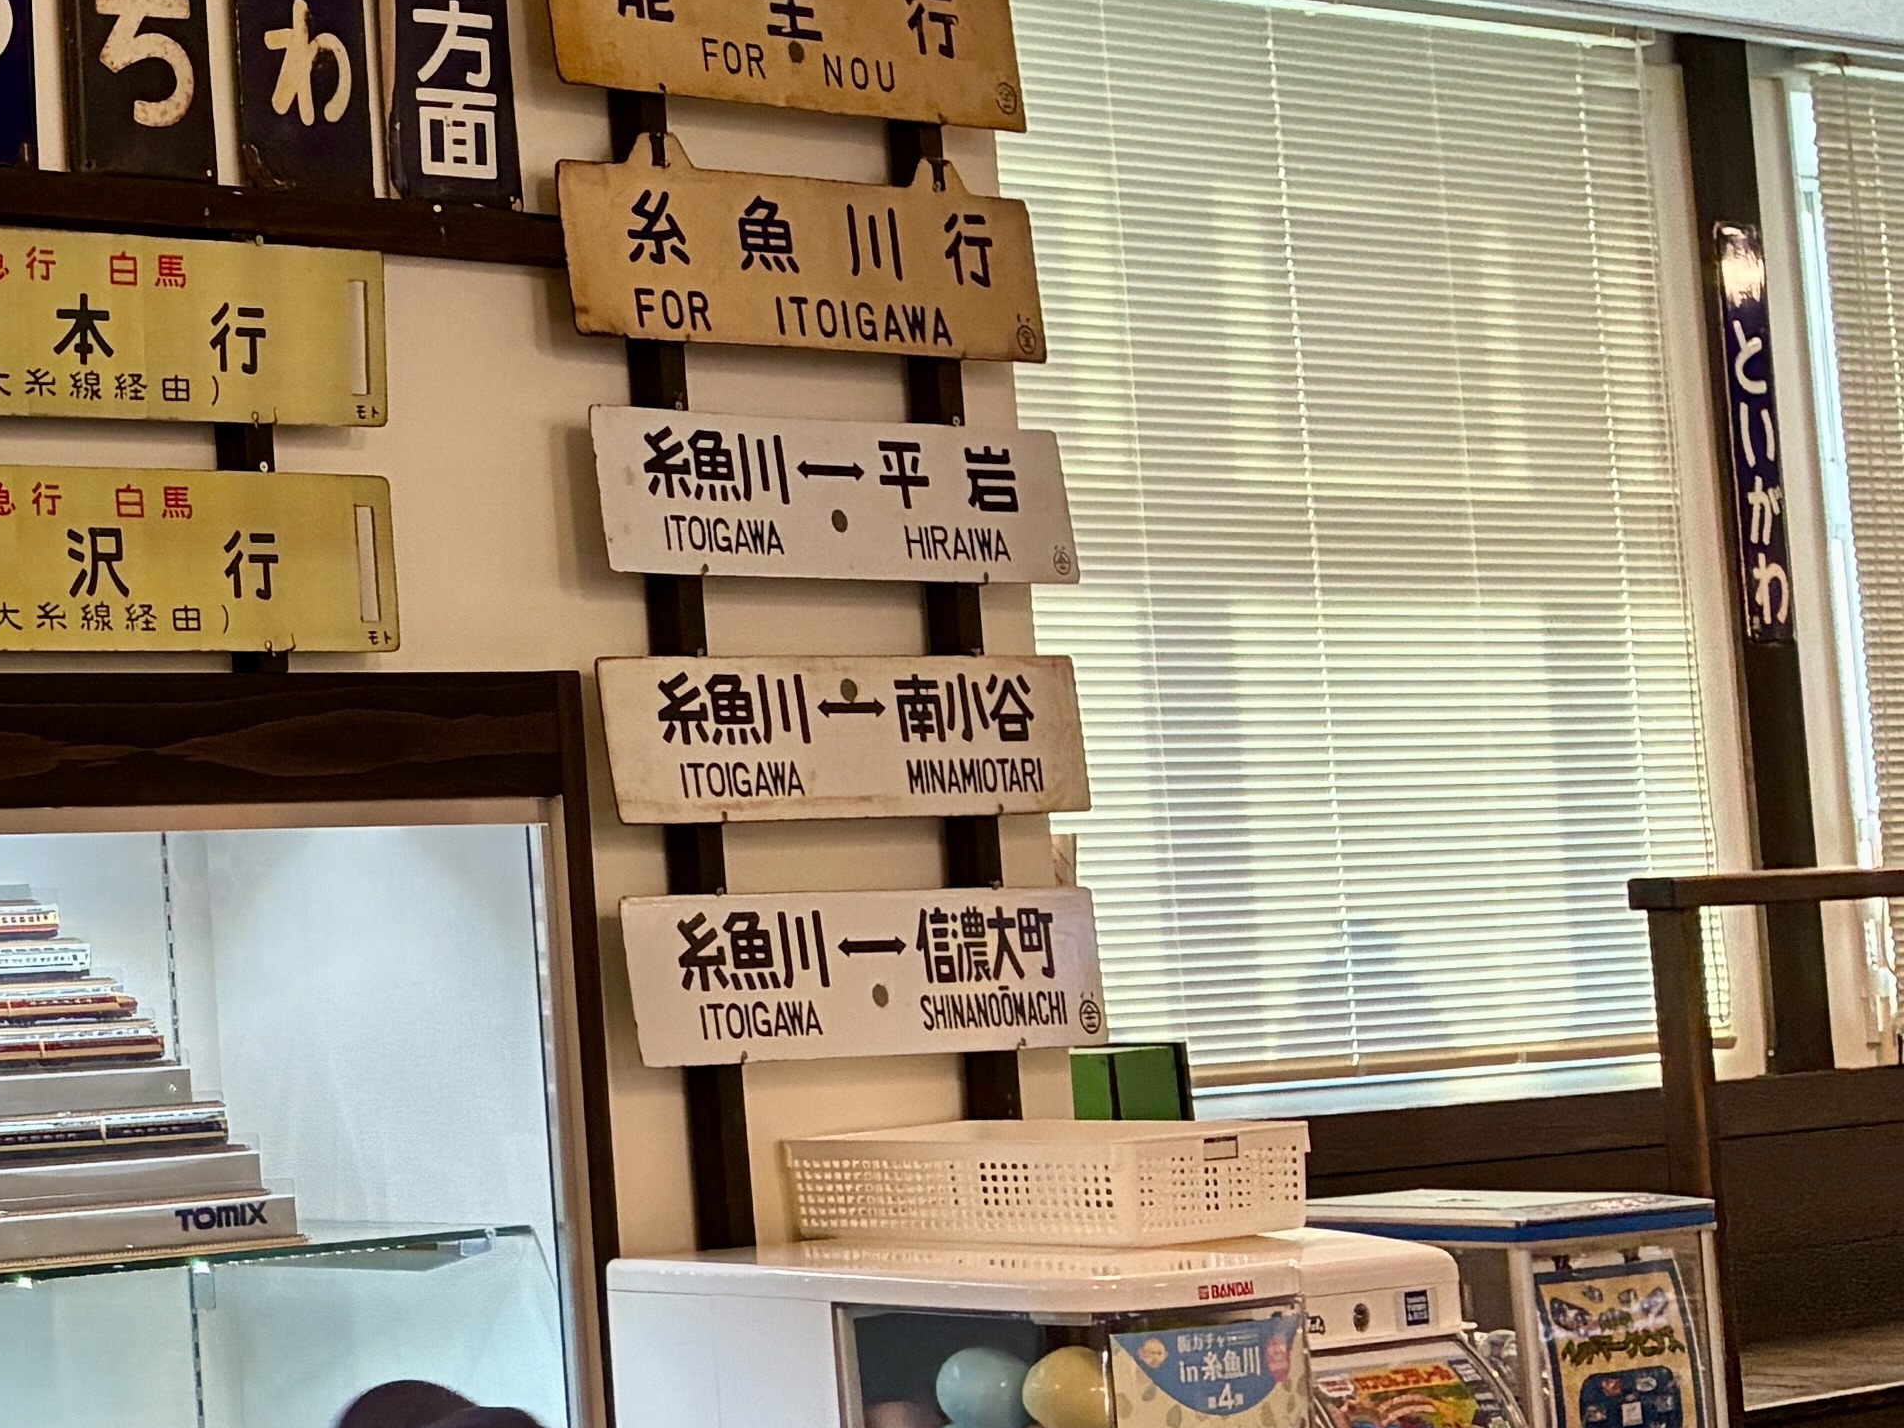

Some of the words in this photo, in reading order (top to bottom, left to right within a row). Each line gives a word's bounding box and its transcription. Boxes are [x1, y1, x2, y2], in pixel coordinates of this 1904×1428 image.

[701, 37, 767, 79] FOR
[823, 53, 896, 93] NOU
[627, 189, 994, 289] 糸魚川行
[109, 250, 188, 290] 白馬
[633, 287, 713, 332] FOR
[774, 295, 954, 347] ITOIGAWA
[643, 426, 791, 506] 糸魚川
[878, 438, 1020, 514] 平岩
[114, 483, 195, 520] 白馬
[663, 514, 786, 557] ITOIGAWA
[904, 525, 1013, 565] HIRAIWA
[657, 670, 813, 746] 糸魚川
[892, 673, 1035, 744] 南小谷
[680, 761, 806, 799] ITOIGAWA
[908, 758, 1044, 795] MINAMIOTARI
[676, 910, 831, 993] 糸魚川
[914, 906, 1055, 984] 信濃大町
[699, 1000, 825, 1043] ITOIGAWA
[175, 1201, 268, 1232] TOMIX
[1211, 1279, 1255, 1301] BANDAI
[1178, 1359, 1199, 1384] in
[1201, 1345, 1262, 1383] 糸魚川
